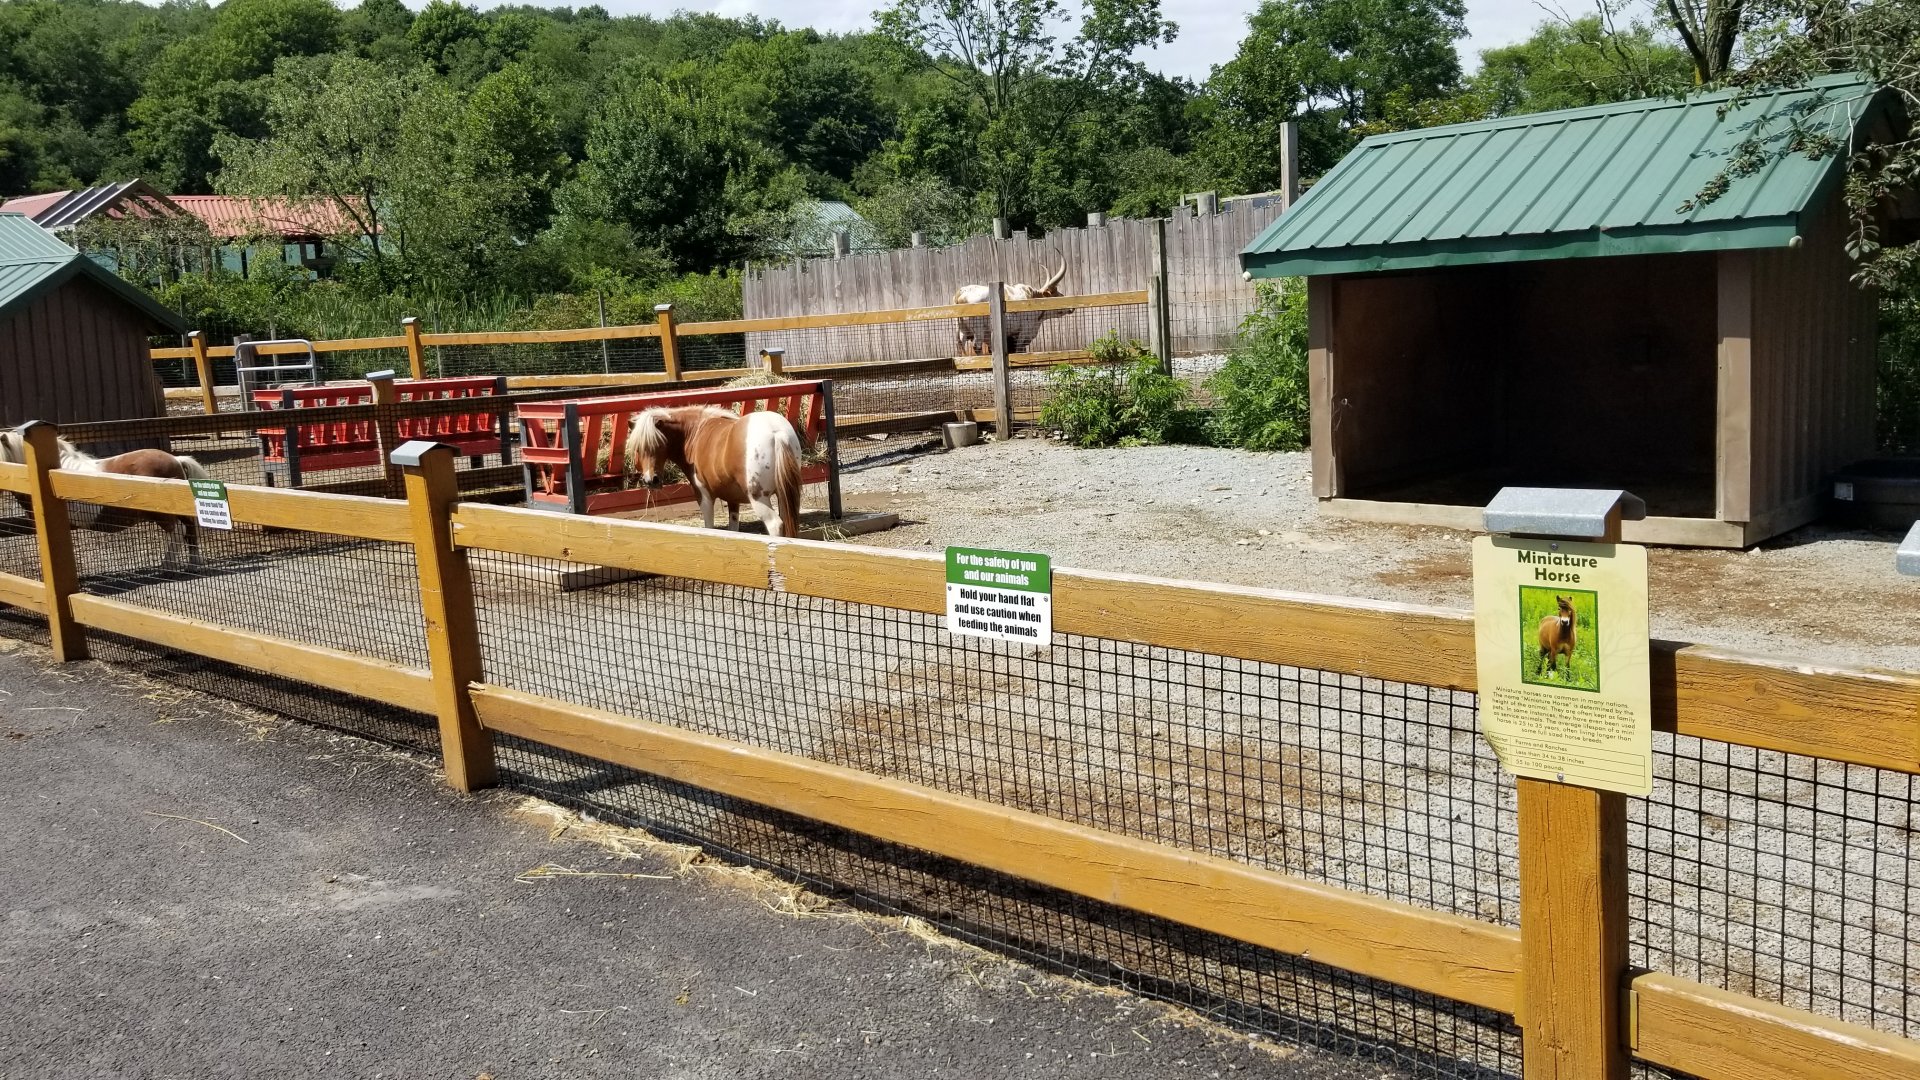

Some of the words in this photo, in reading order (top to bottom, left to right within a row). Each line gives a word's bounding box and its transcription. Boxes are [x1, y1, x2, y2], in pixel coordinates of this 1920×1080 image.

[956, 553, 969, 565] For
[970, 554, 983, 566] the
[984, 556, 1010, 570] safety
[1011, 558, 1020, 569] of
[1021, 561, 1037, 572] you
[1518, 550, 1598, 568] Miniature
[964, 570, 980, 580] and
[981, 572, 995, 582] our
[996, 573, 1029, 586] animals
[1535, 568, 1581, 583] Horse
[960, 588, 978, 600] Hold
[979, 592, 997, 602] your
[999, 593, 1019, 605] hand
[1020, 595, 1035, 607] flat
[955, 604, 969, 614] and
[971, 606, 985, 616] use
[987, 608, 1017, 620] caution
[1019, 611, 1042, 623] when
[959, 618, 988, 632] feeding
[990, 622, 1003, 633] the
[1005, 624, 1038, 638] animals
[1496, 686, 1522, 695] Miniature
[1580, 704, 1614, 713] determined
[1617, 715, 1636, 724] family
[1580, 729, 1595, 737] living
[1545, 744, 1568, 752] Ranches
